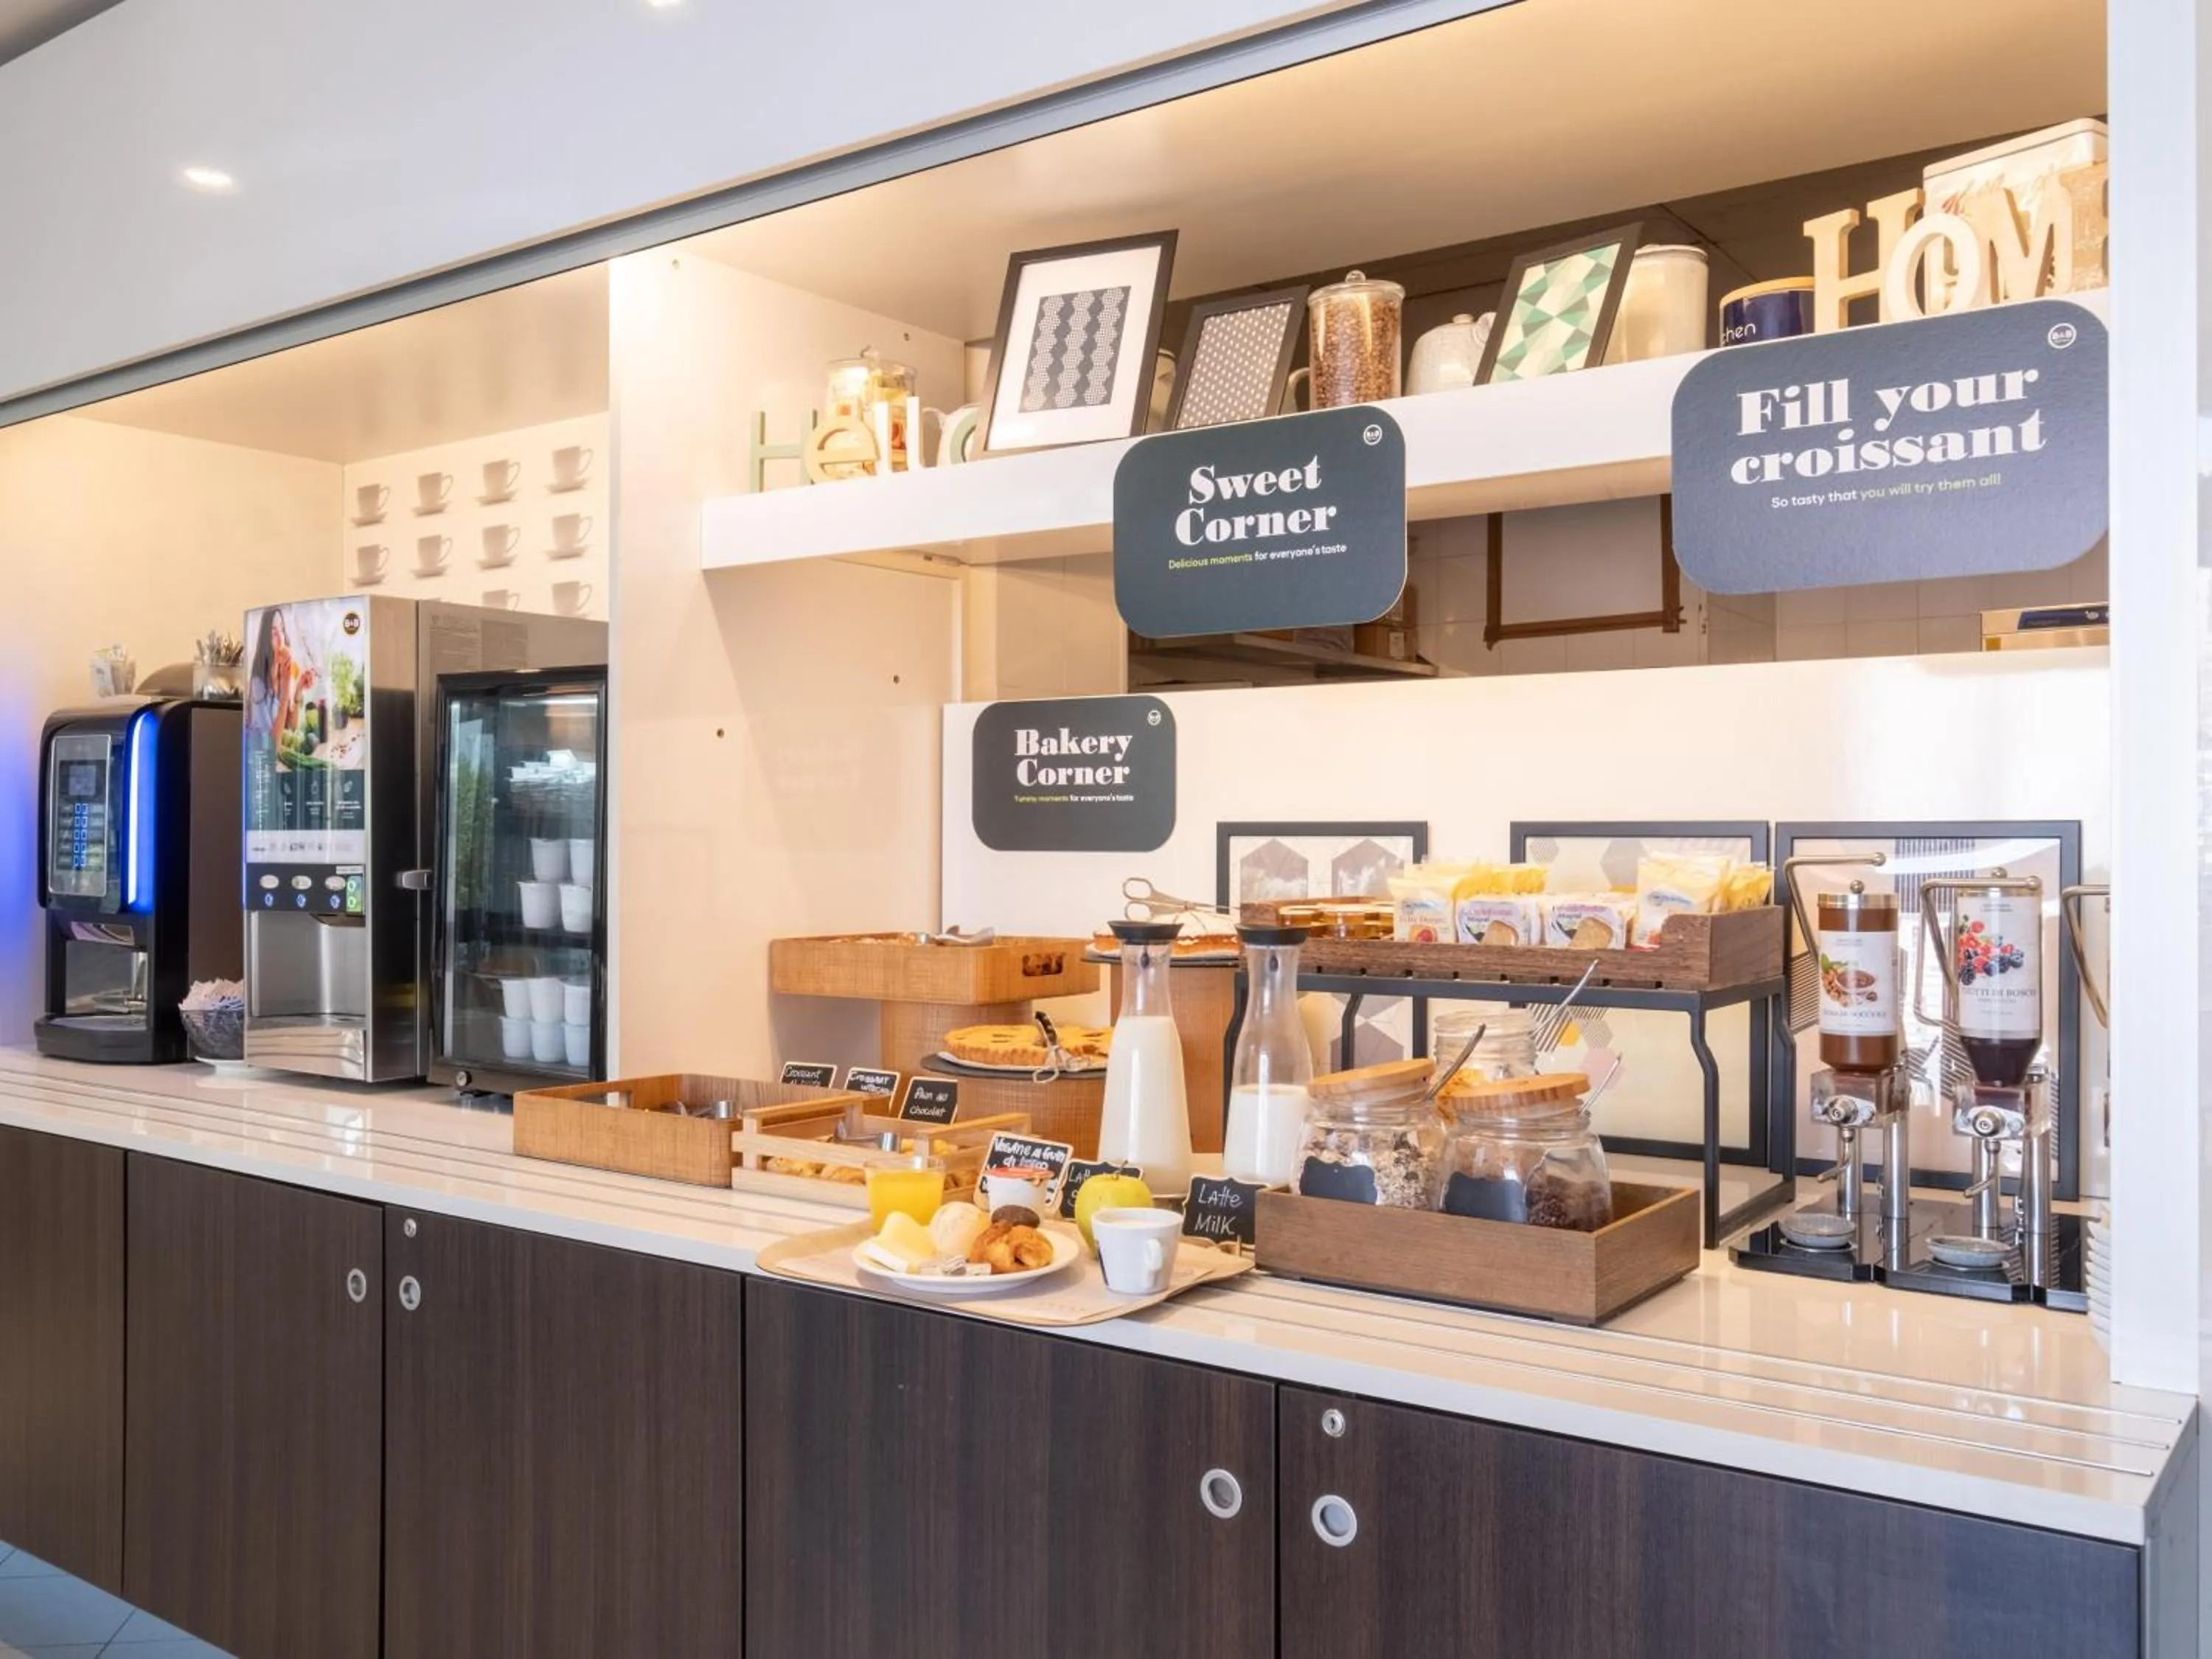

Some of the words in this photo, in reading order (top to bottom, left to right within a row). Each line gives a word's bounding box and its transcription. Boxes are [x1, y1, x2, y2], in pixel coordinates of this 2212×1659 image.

[1736, 378, 1852, 436] Fill
[1874, 369, 2039, 432] your
[1731, 408, 2047, 484] croissant
[1188, 454, 1323, 505] Sweet
[1771, 496, 1789, 509] So
[1791, 493, 1825, 507] tasty
[1828, 490, 1857, 503] that
[1860, 487, 1886, 502] you
[1889, 483, 1911, 495] will
[1914, 481, 1934, 495] try
[1938, 477, 1976, 492] them
[1979, 473, 2002, 487] all!
[1175, 505, 1338, 546] Corner
[1169, 558, 1208, 570] Delicious
[1210, 553, 1253, 566] moments
[1254, 550, 1268, 560] for
[1269, 544, 1321, 560] everyone's
[1321, 543, 1347, 554] taste
[1014, 728, 1133, 762] Bakery
[1017, 758, 1130, 787] Corner
